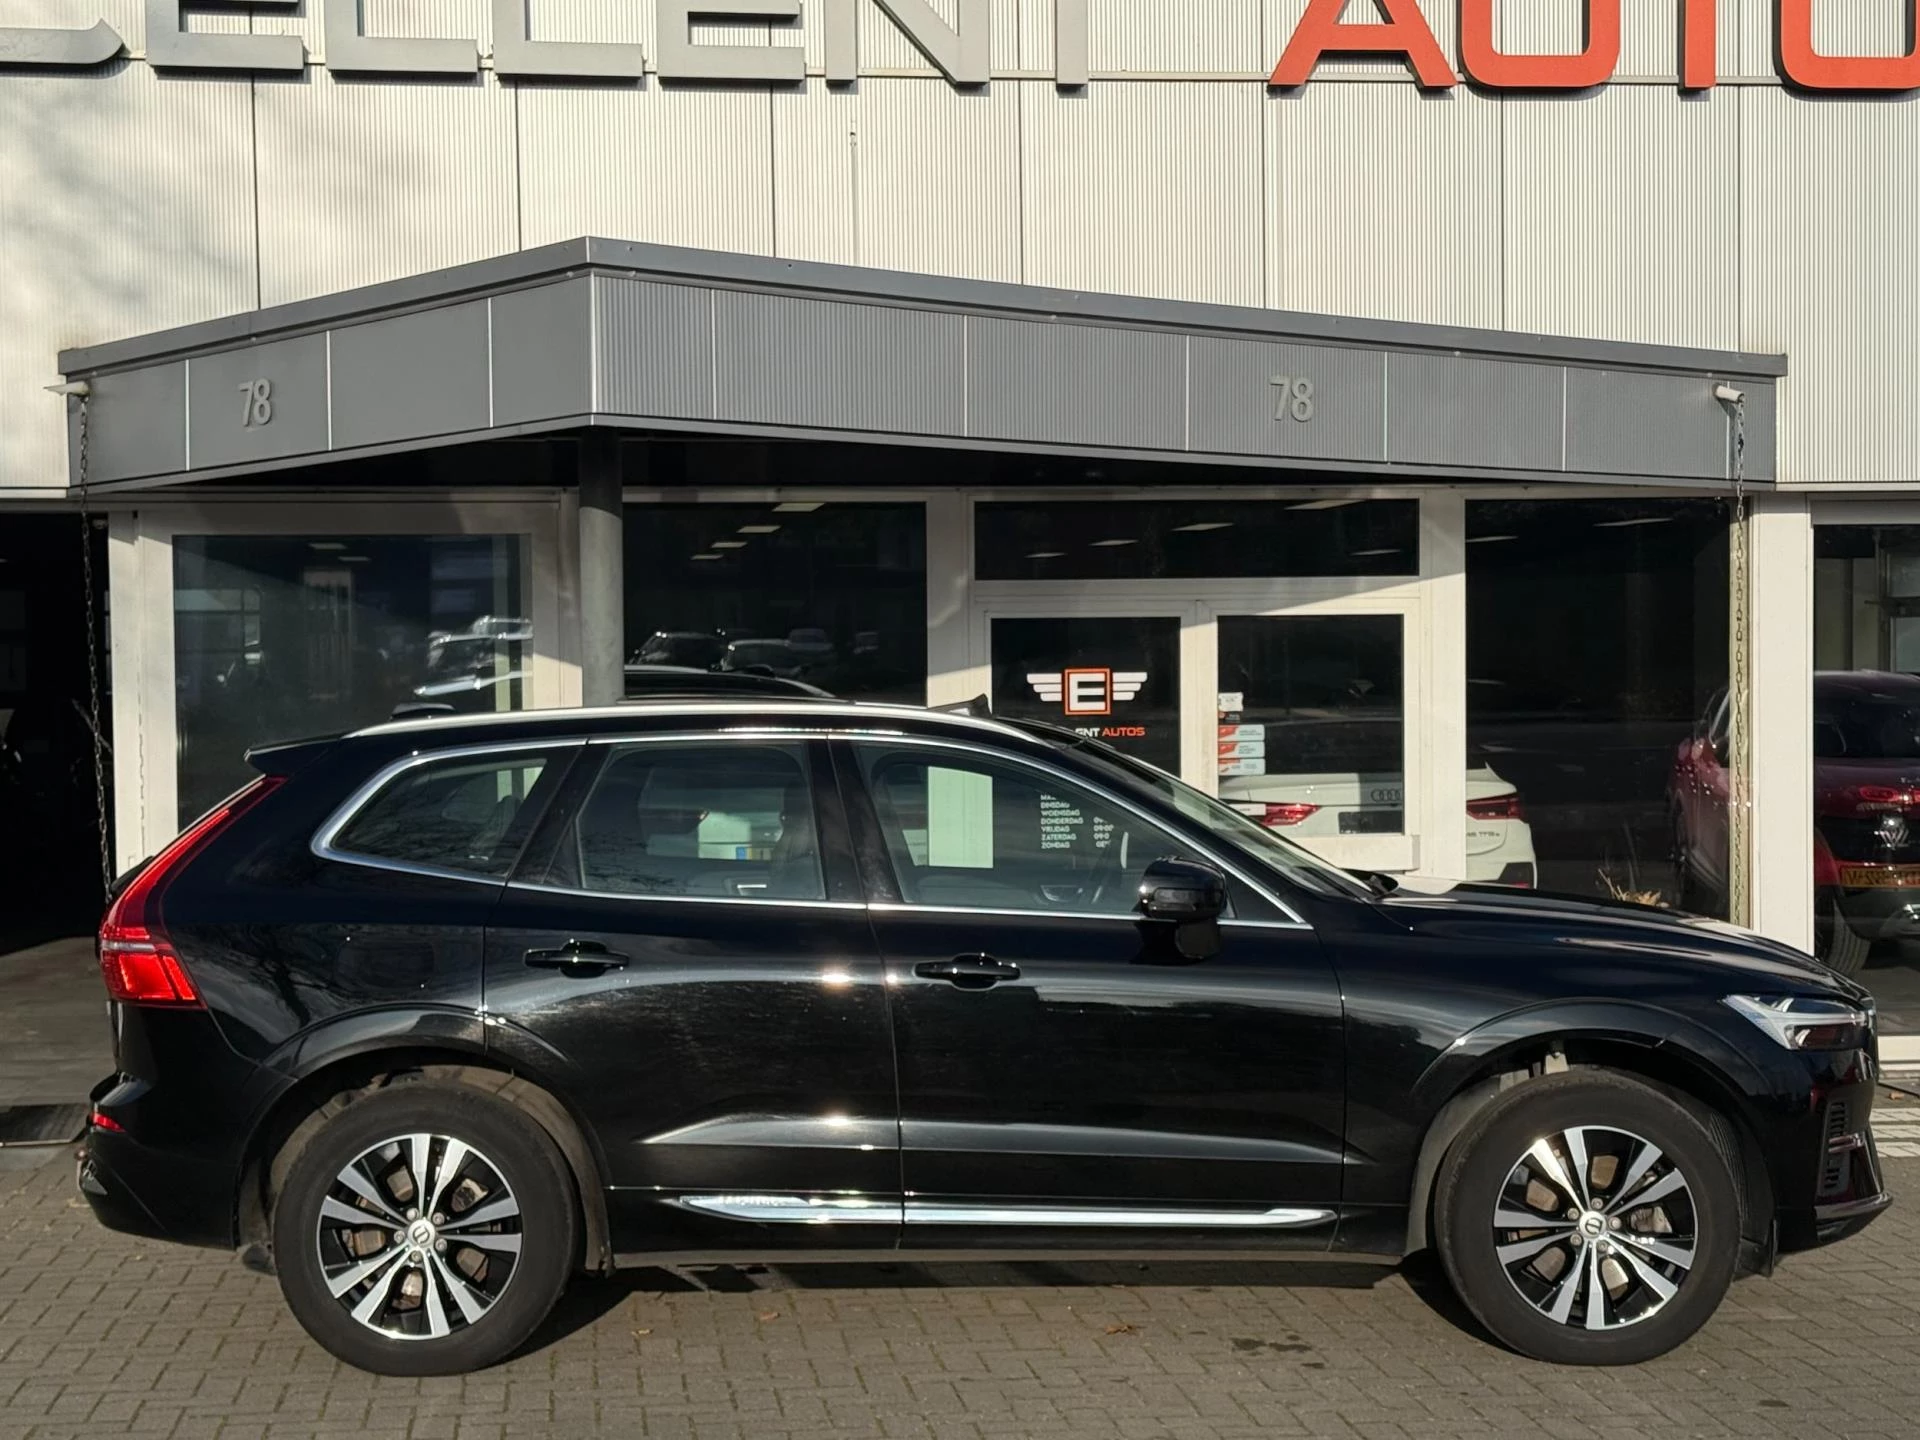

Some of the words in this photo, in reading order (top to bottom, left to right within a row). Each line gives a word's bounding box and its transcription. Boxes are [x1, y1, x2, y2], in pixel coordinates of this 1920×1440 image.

[239, 379, 271, 427] 78
[1268, 377, 1314, 422] 78
[1102, 726, 1146, 737] AUTOS
[1040, 809, 1080, 817] WOENSDAG
[1040, 817, 1084, 825] DONDERDAG
[1041, 833, 1077, 841] ZATERDAG
[1041, 841, 1071, 849] ZONDAG
